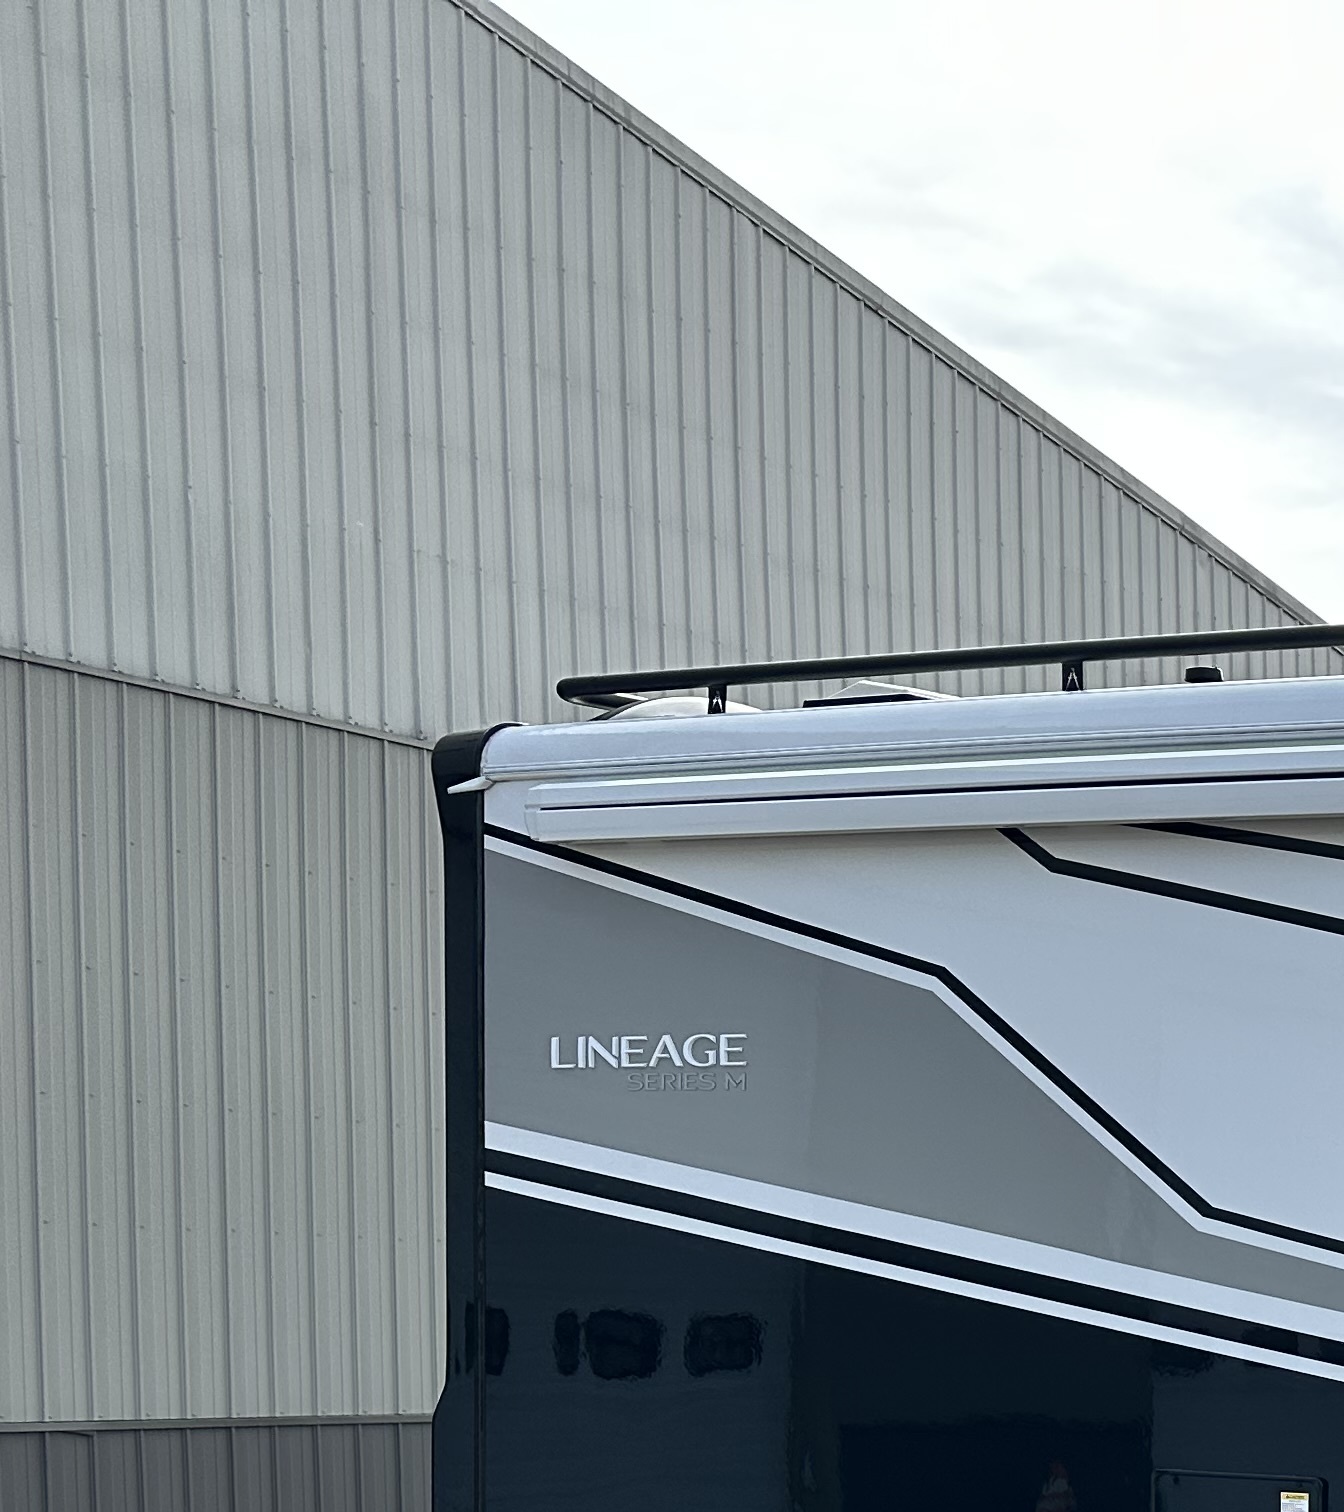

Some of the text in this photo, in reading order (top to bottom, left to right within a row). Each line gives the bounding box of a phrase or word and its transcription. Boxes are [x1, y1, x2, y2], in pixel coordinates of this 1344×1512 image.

[550, 1033, 748, 1069] LINEAGE
[627, 1072, 747, 1092] SERIES M
